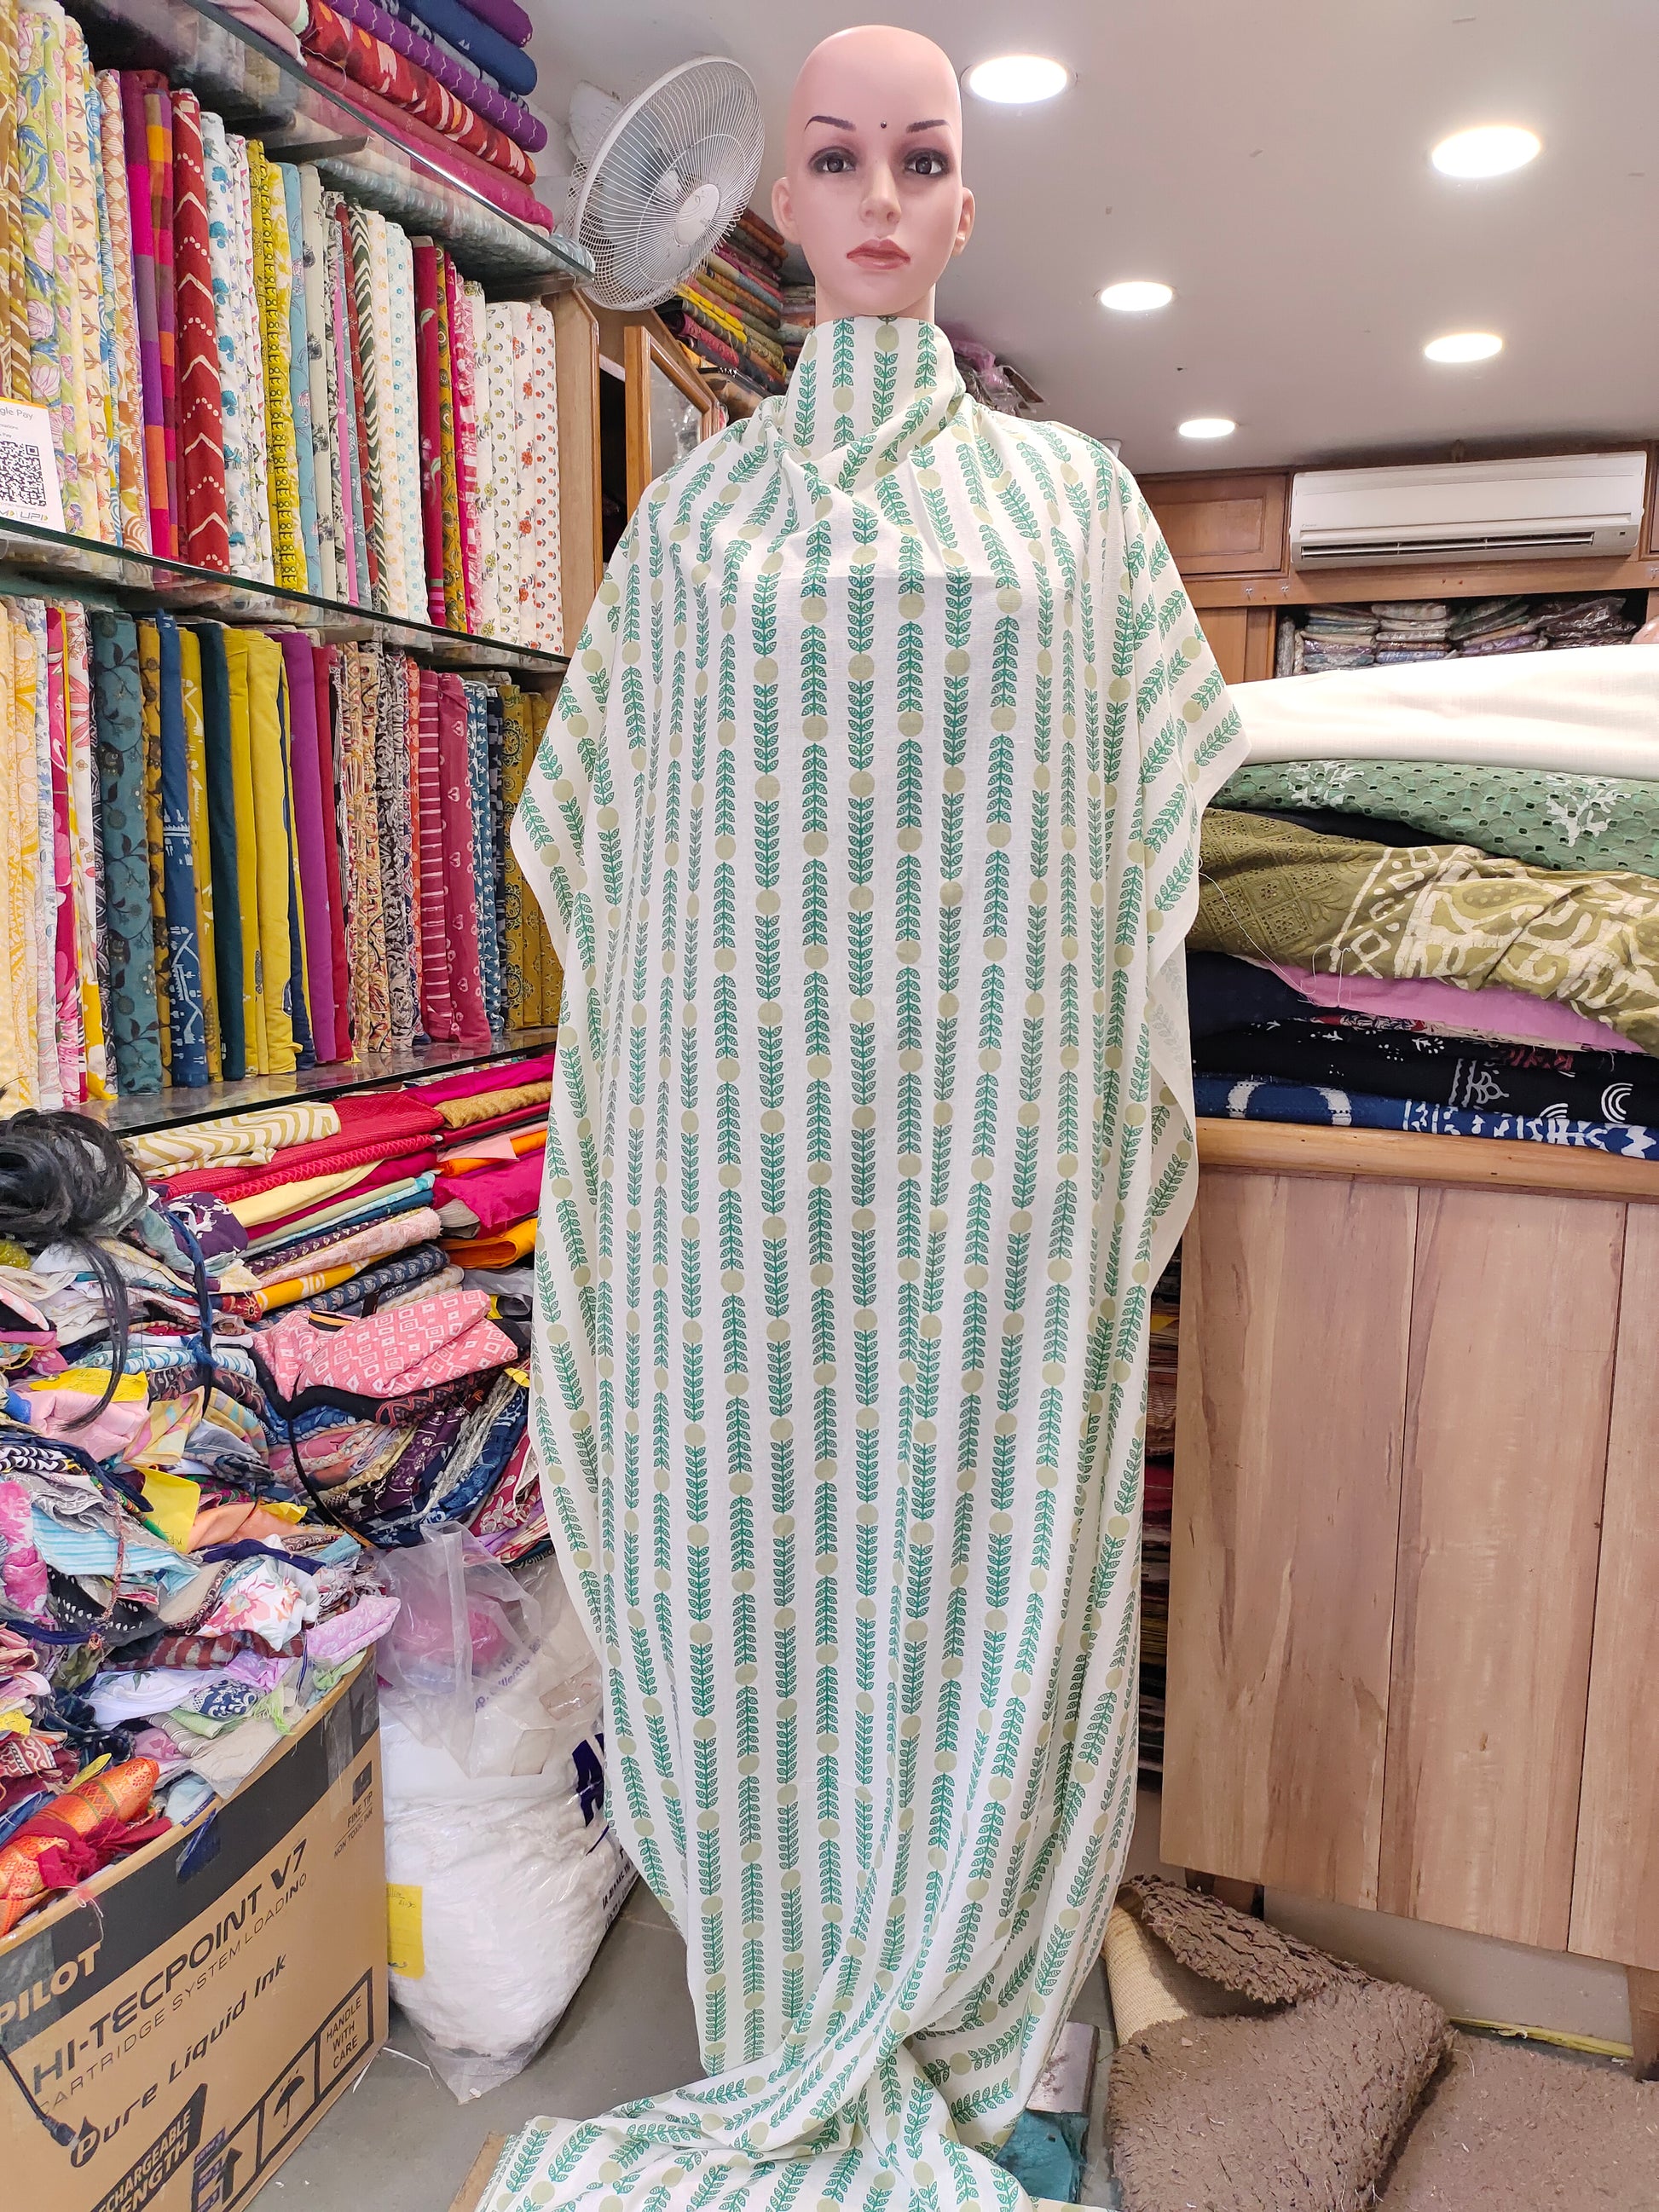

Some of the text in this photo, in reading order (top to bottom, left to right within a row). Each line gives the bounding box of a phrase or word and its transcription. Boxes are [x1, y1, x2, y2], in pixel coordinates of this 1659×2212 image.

[16, 408, 33, 420] Pay
[20, 511, 43, 521] UPI
[334, 1839, 346, 1858] NON
[364, 1806, 373, 1822] INK
[347, 1790, 373, 1828] FINE TIP
[0, 1941, 101, 2026] PILOT
[33, 1838, 307, 2095] HI-TECPOINT V7
[37, 2007, 165, 2120] CARTRIDGE
[172, 1939, 240, 2012] SYSTEM
[168, 1990, 247, 2085] Liquid
[254, 1953, 287, 1998] Ink
[327, 1995, 361, 2043] HANDLE
[332, 2020, 355, 2052] WITH
[332, 2034, 358, 2069] CARE
